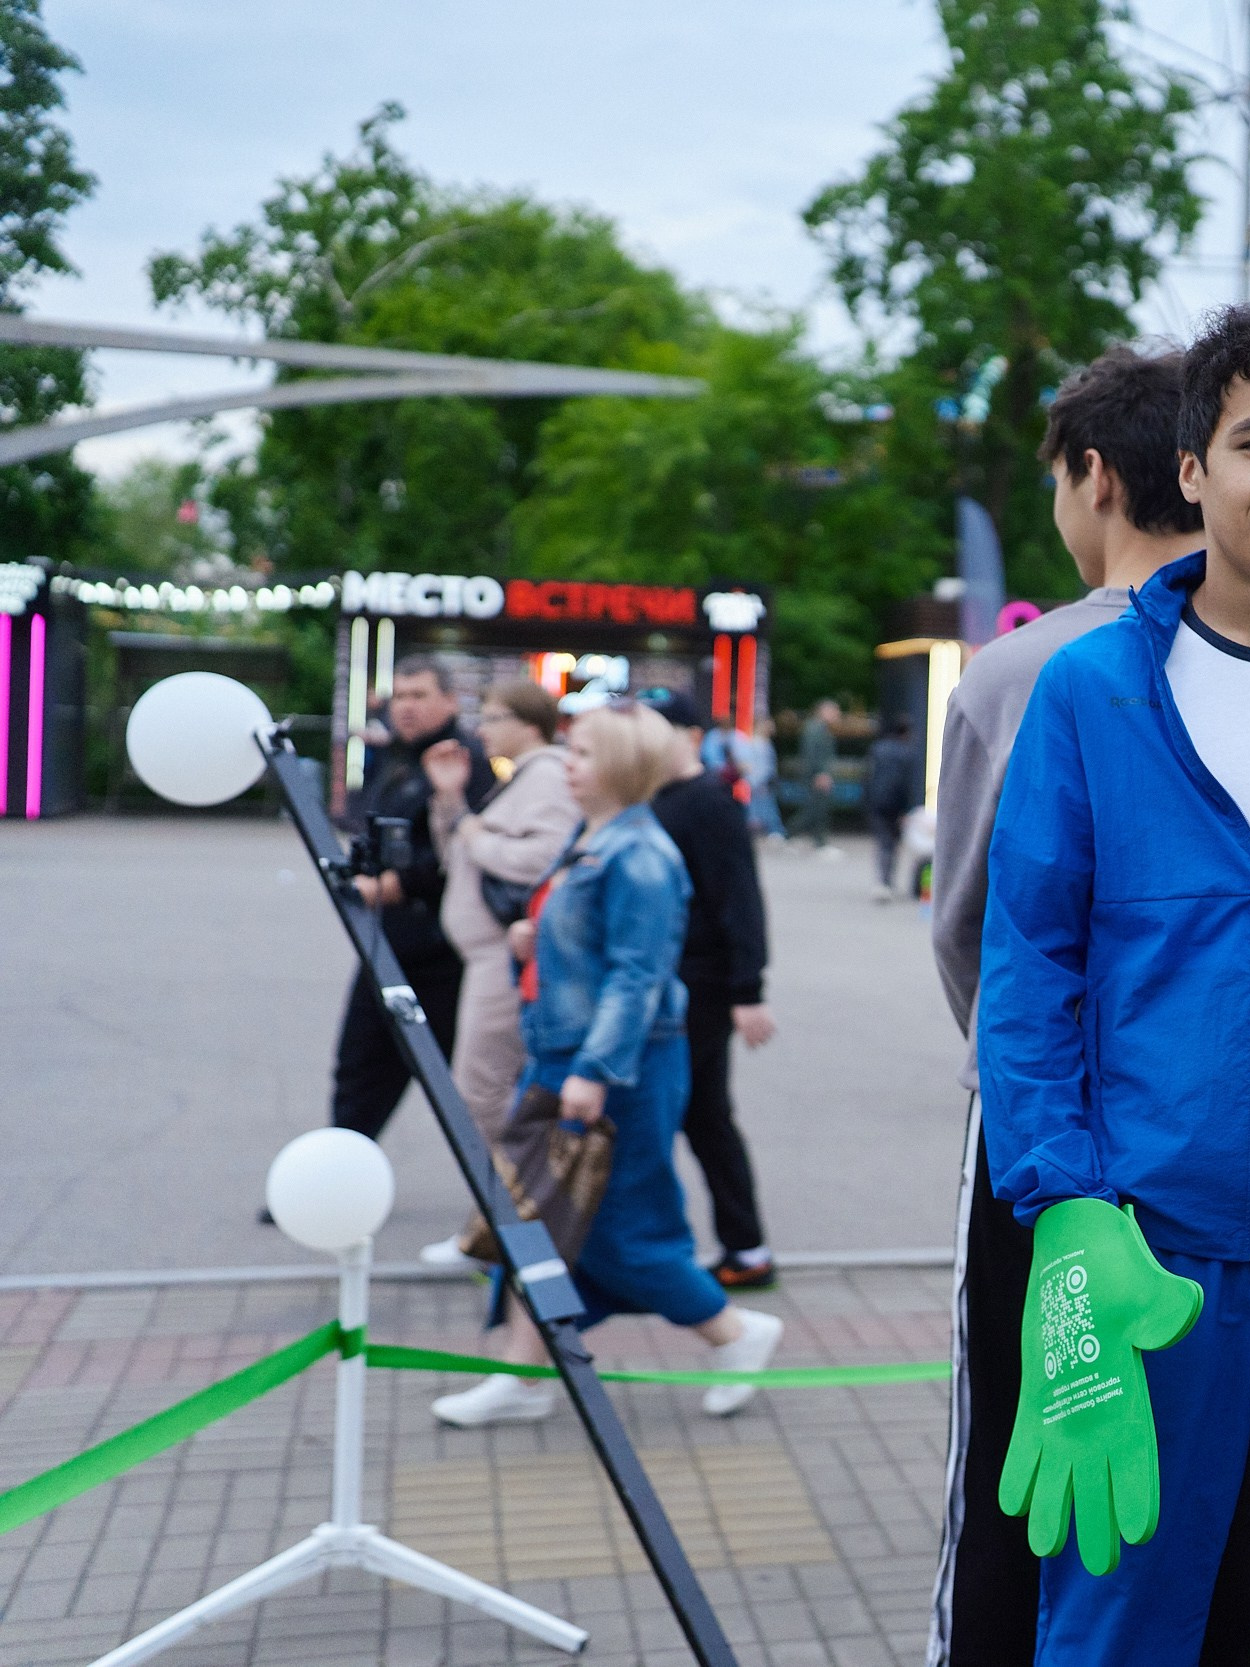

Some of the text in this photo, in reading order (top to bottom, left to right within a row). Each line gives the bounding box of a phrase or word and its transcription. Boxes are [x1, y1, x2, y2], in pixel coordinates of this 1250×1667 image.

[342, 570, 505, 619] МЕСТО
[506, 579, 697, 624] ВСТРЕЧИ
[1070, 1374, 1093, 1389] вашем
[1088, 1376, 1121, 1396] торговой
[1073, 1389, 1088, 1400] сети
[1095, 1387, 1123, 1403] Узнайте
[1071, 1399, 1095, 1413] больше
